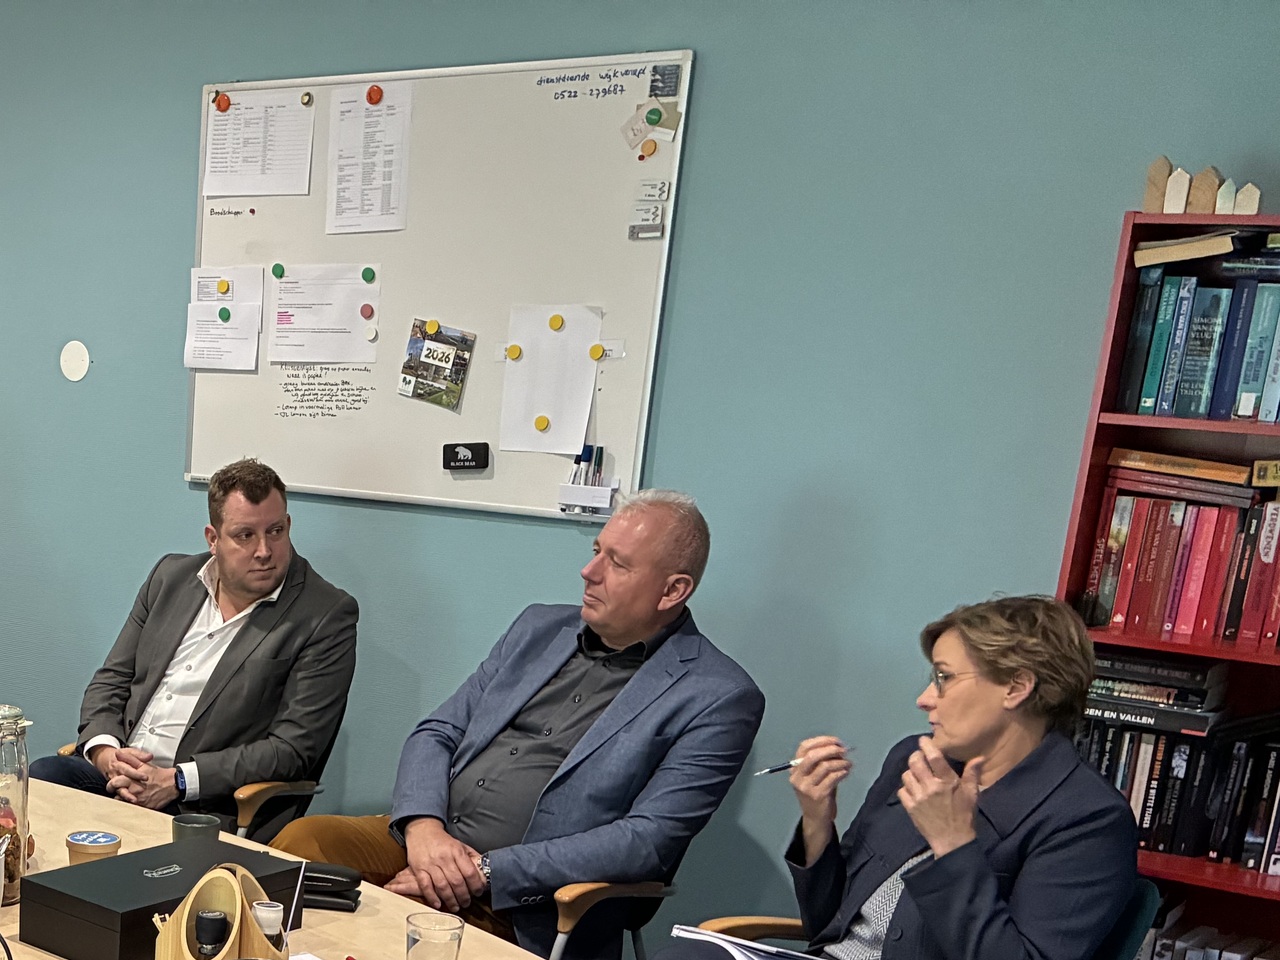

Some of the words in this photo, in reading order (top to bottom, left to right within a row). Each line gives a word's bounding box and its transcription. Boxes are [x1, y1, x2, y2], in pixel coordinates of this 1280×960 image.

[554, 89, 578, 100] 0522
[589, 84, 626, 99] 279687
[424, 347, 451, 364] 2026
[1104, 710, 1116, 718] EN
[1120, 713, 1155, 725] VALLEN
